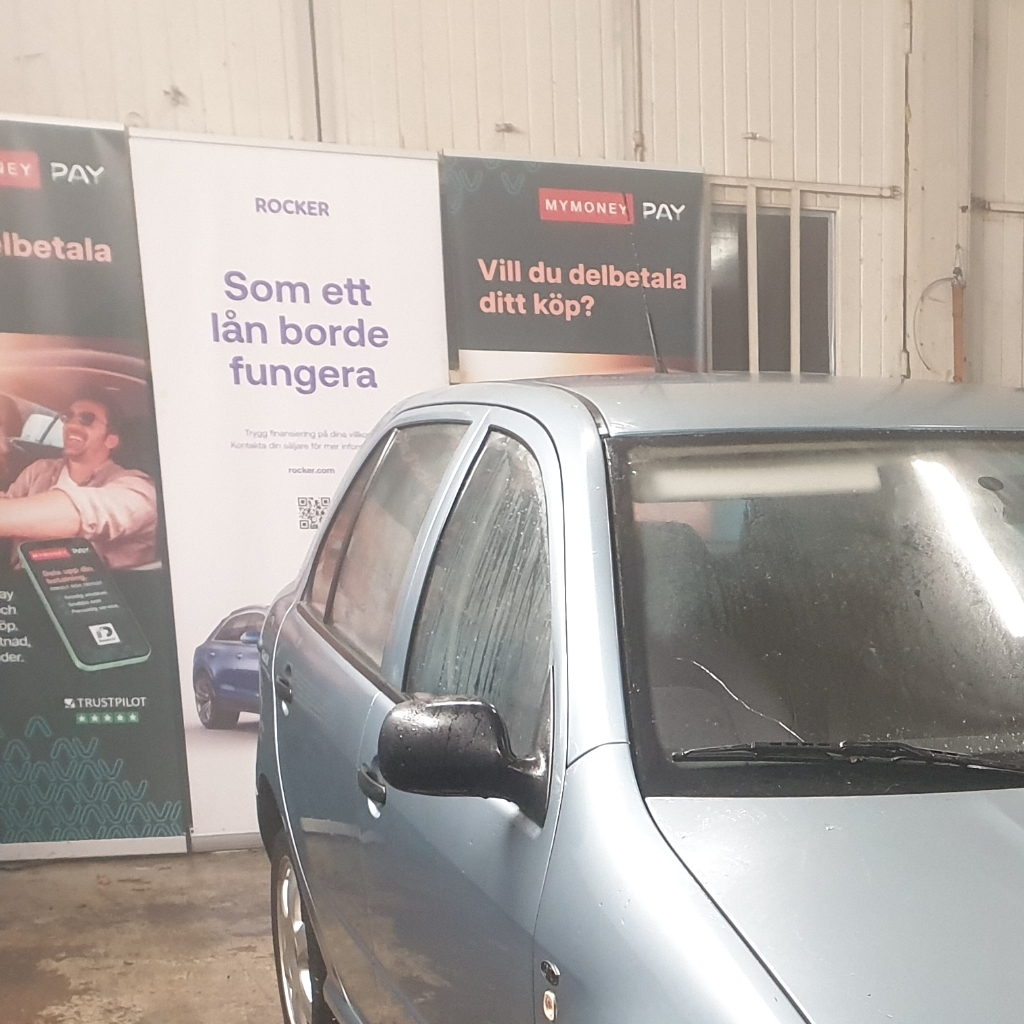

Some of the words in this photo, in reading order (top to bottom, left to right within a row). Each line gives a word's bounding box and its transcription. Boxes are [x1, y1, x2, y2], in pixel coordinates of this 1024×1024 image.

[50, 162, 104, 184] PAY
[255, 197, 330, 217] ROCKER
[545, 199, 628, 215] MYMONEY
[642, 202, 686, 221] PAY
[0, 231, 112, 263] lbetala
[224, 270, 310, 304] Som
[322, 277, 372, 306] ett
[477, 258, 522, 282] Vill
[528, 261, 562, 284] du
[568, 263, 687, 290] delbetala
[479, 290, 526, 314] ditt
[533, 292, 595, 321] köp?
[211, 309, 268, 344] lån
[279, 315, 389, 348] borde
[229, 355, 378, 395] fungera
[245, 429, 268, 438] Trygg
[318, 429, 328, 438] på
[76, 696, 147, 708] TRUSTPILOT
